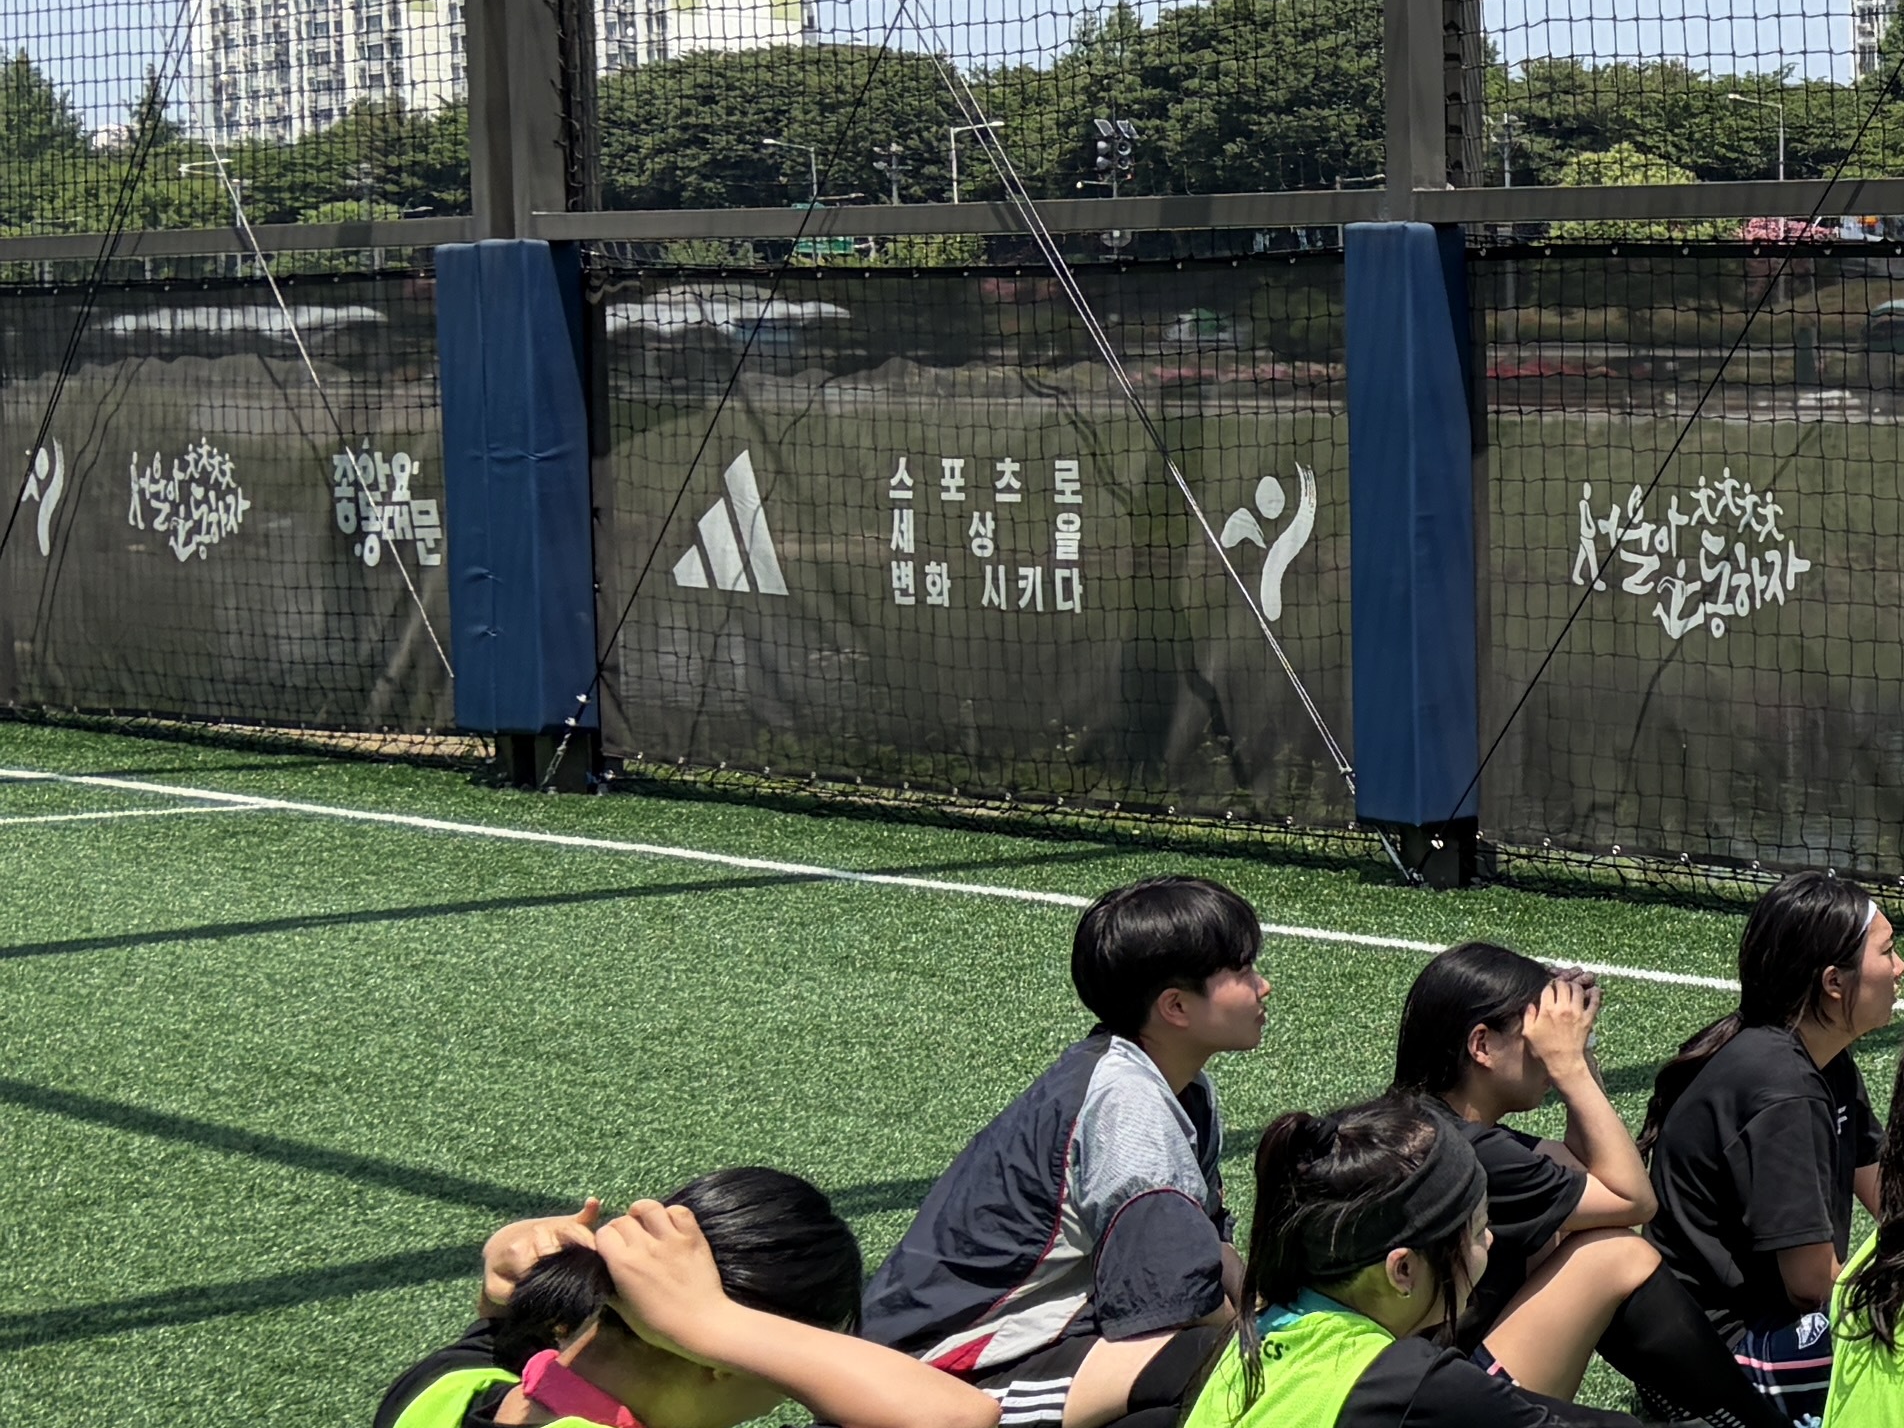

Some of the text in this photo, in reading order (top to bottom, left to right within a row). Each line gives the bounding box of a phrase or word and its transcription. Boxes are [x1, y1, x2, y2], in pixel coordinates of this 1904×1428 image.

[889, 457, 1083, 504] 스포츠로
[890, 509, 1082, 561] 세상을
[891, 560, 1084, 613] 변화 시키다
